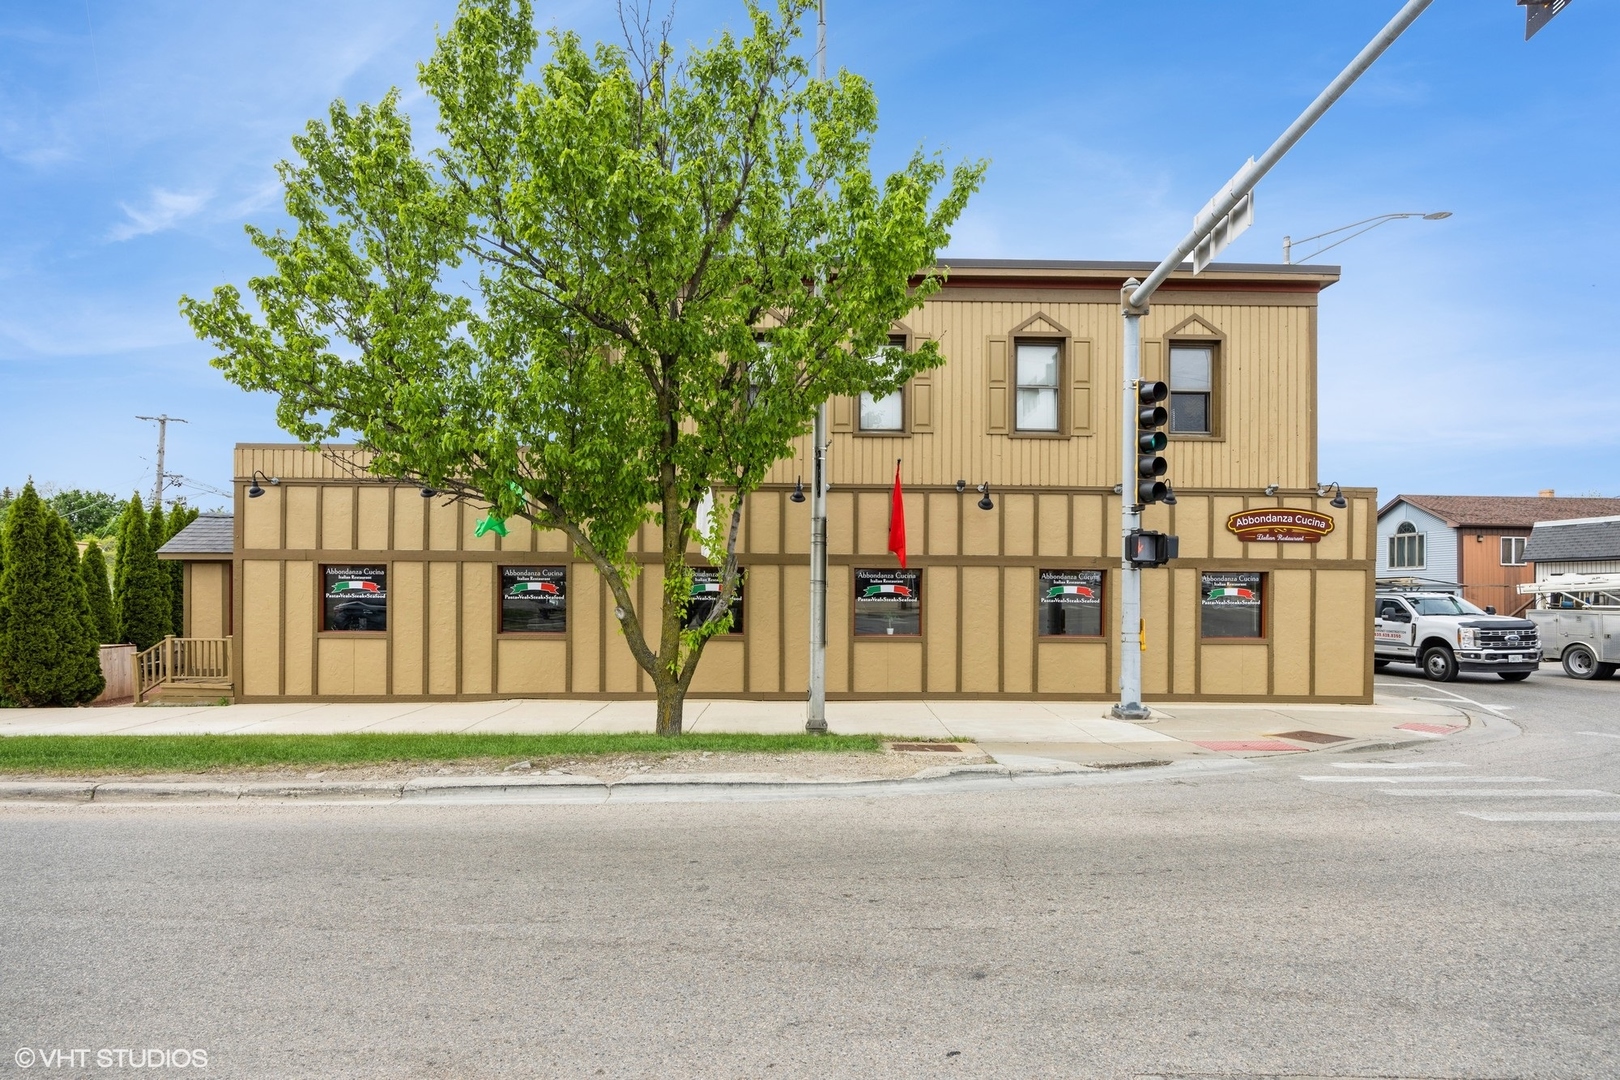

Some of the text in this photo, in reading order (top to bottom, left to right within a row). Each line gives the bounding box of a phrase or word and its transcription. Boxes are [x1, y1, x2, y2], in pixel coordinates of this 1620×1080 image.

[1236, 514, 1326, 529] Abbondanza Cucina
[1256, 533, 1276, 541] Italian
[895, 571, 917, 579] Cucina
[1238, 574, 1260, 582] Cucina
